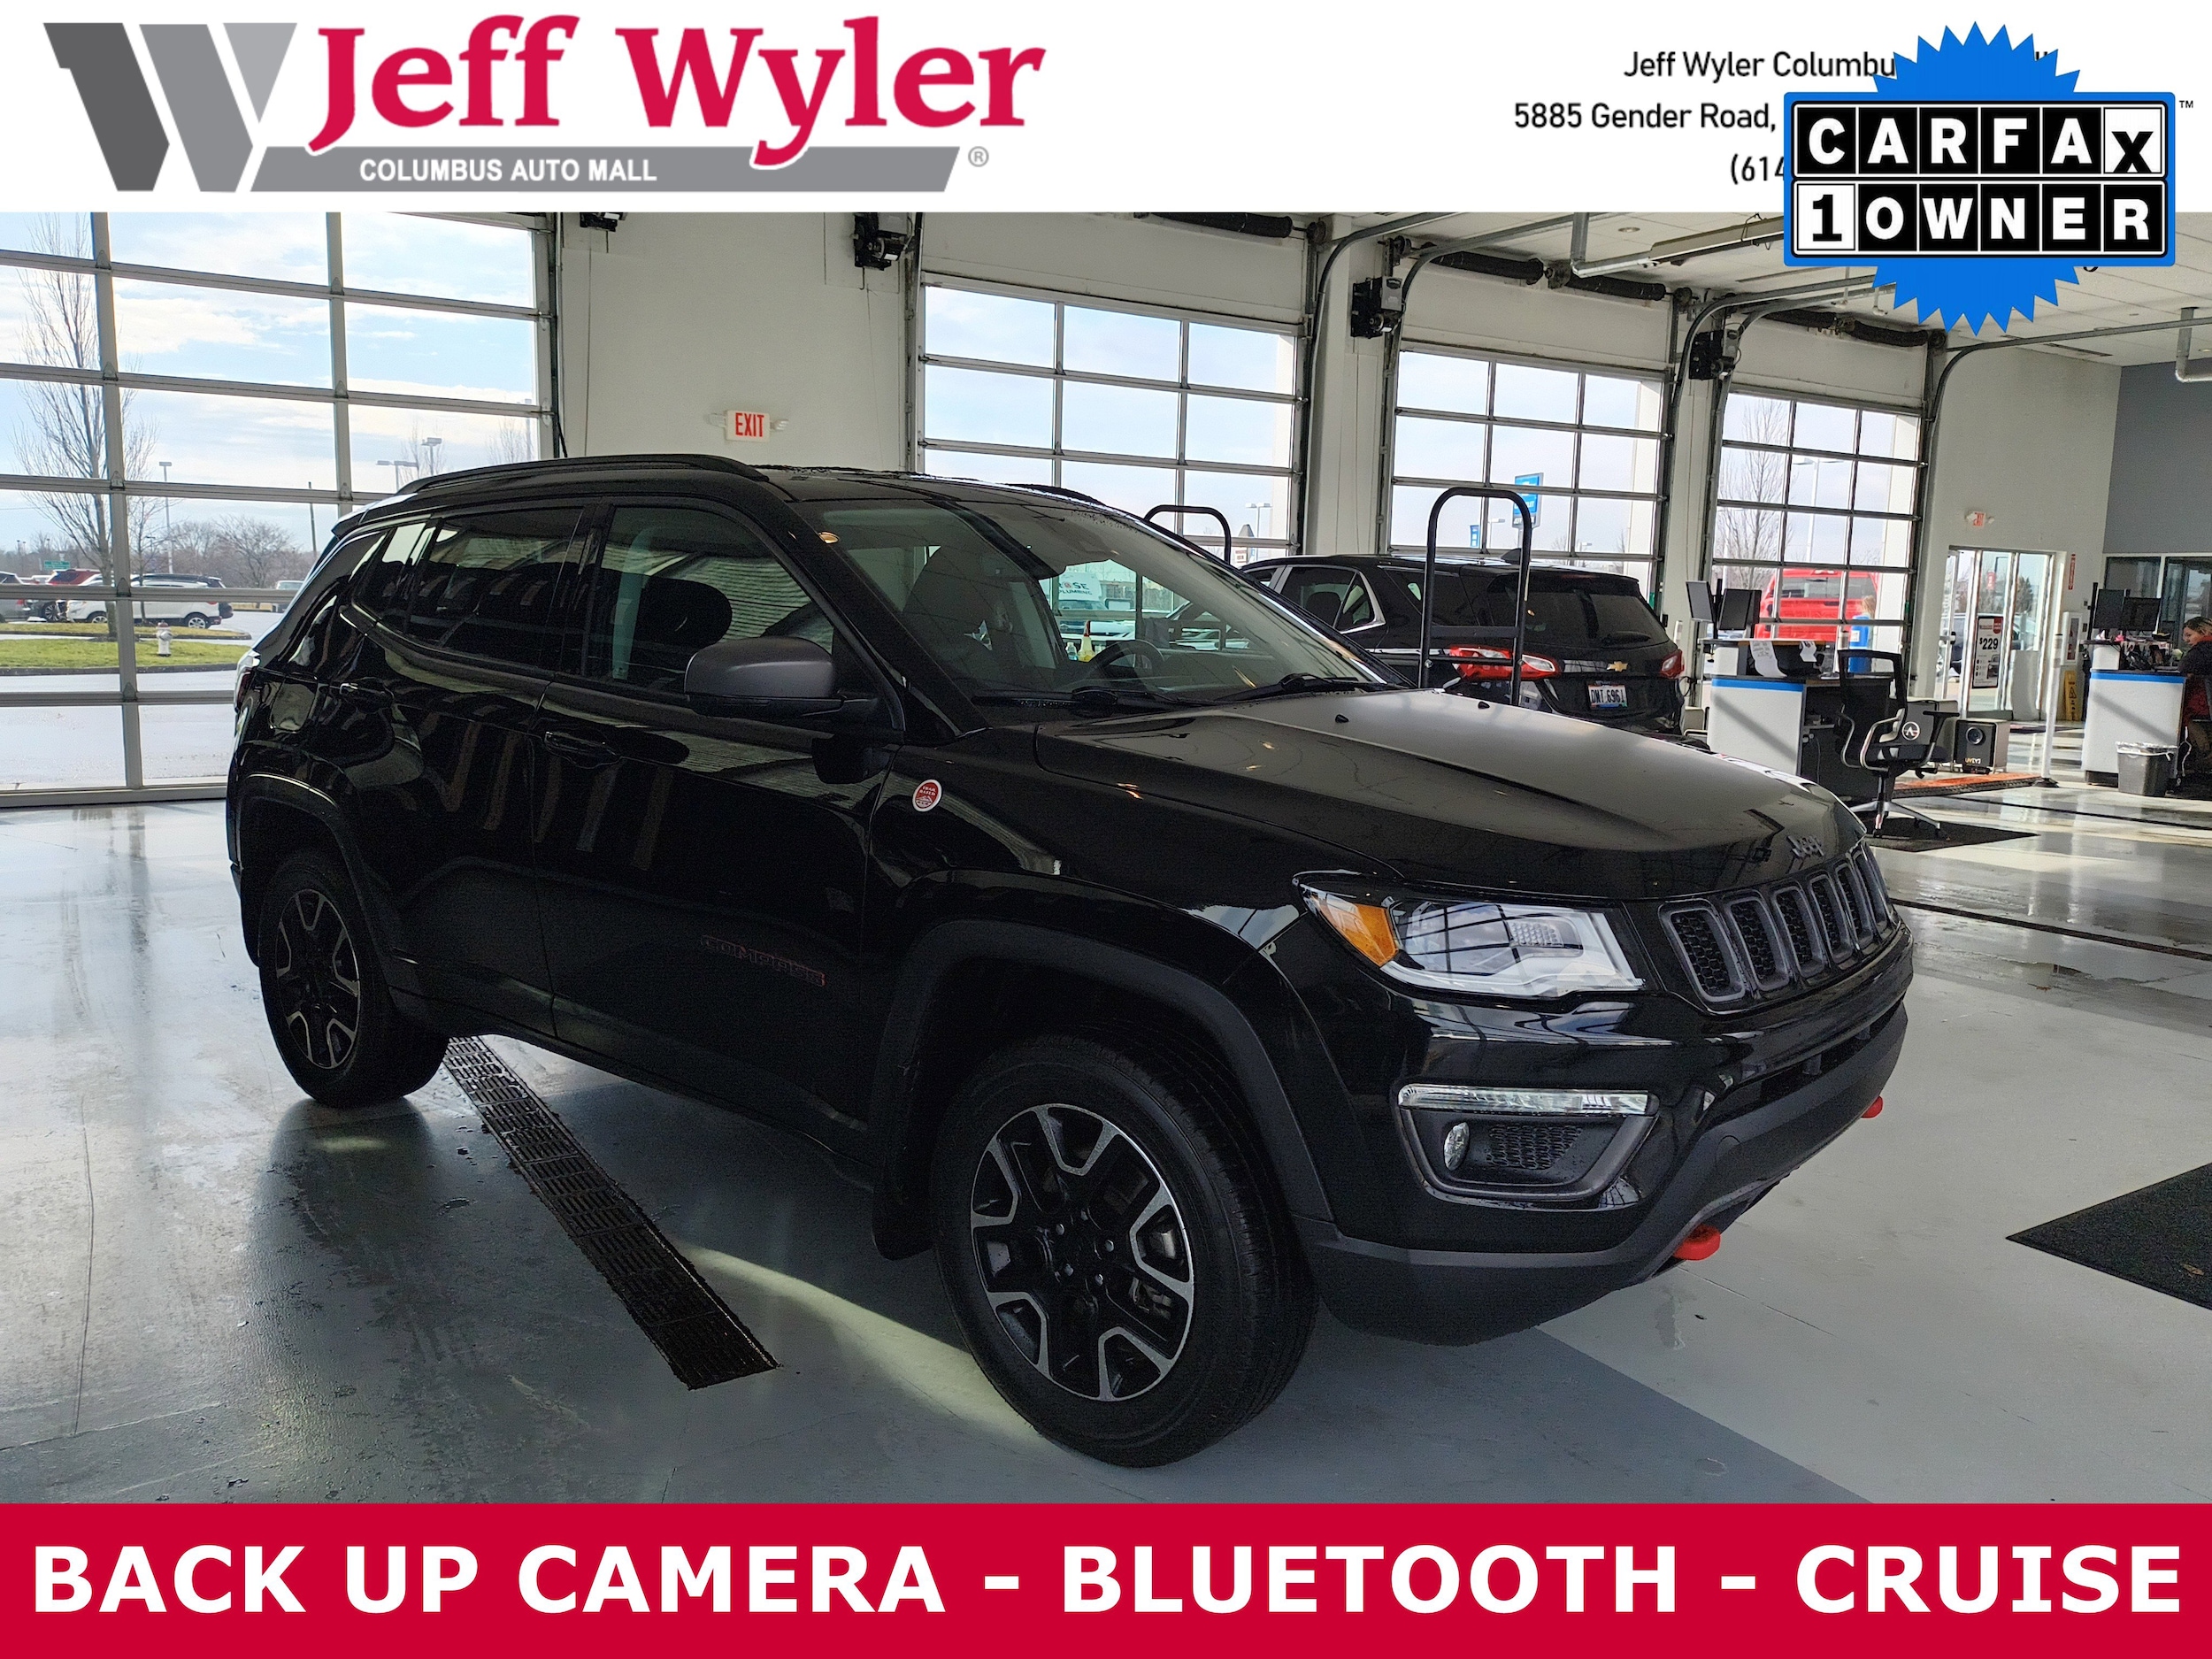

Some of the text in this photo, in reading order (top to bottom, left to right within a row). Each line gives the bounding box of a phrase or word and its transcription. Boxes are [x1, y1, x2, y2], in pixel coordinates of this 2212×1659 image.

[734, 412, 764, 437] EXIT
[1979, 637, 1999, 650] $229
[1786, 836, 1824, 857] Jeep
